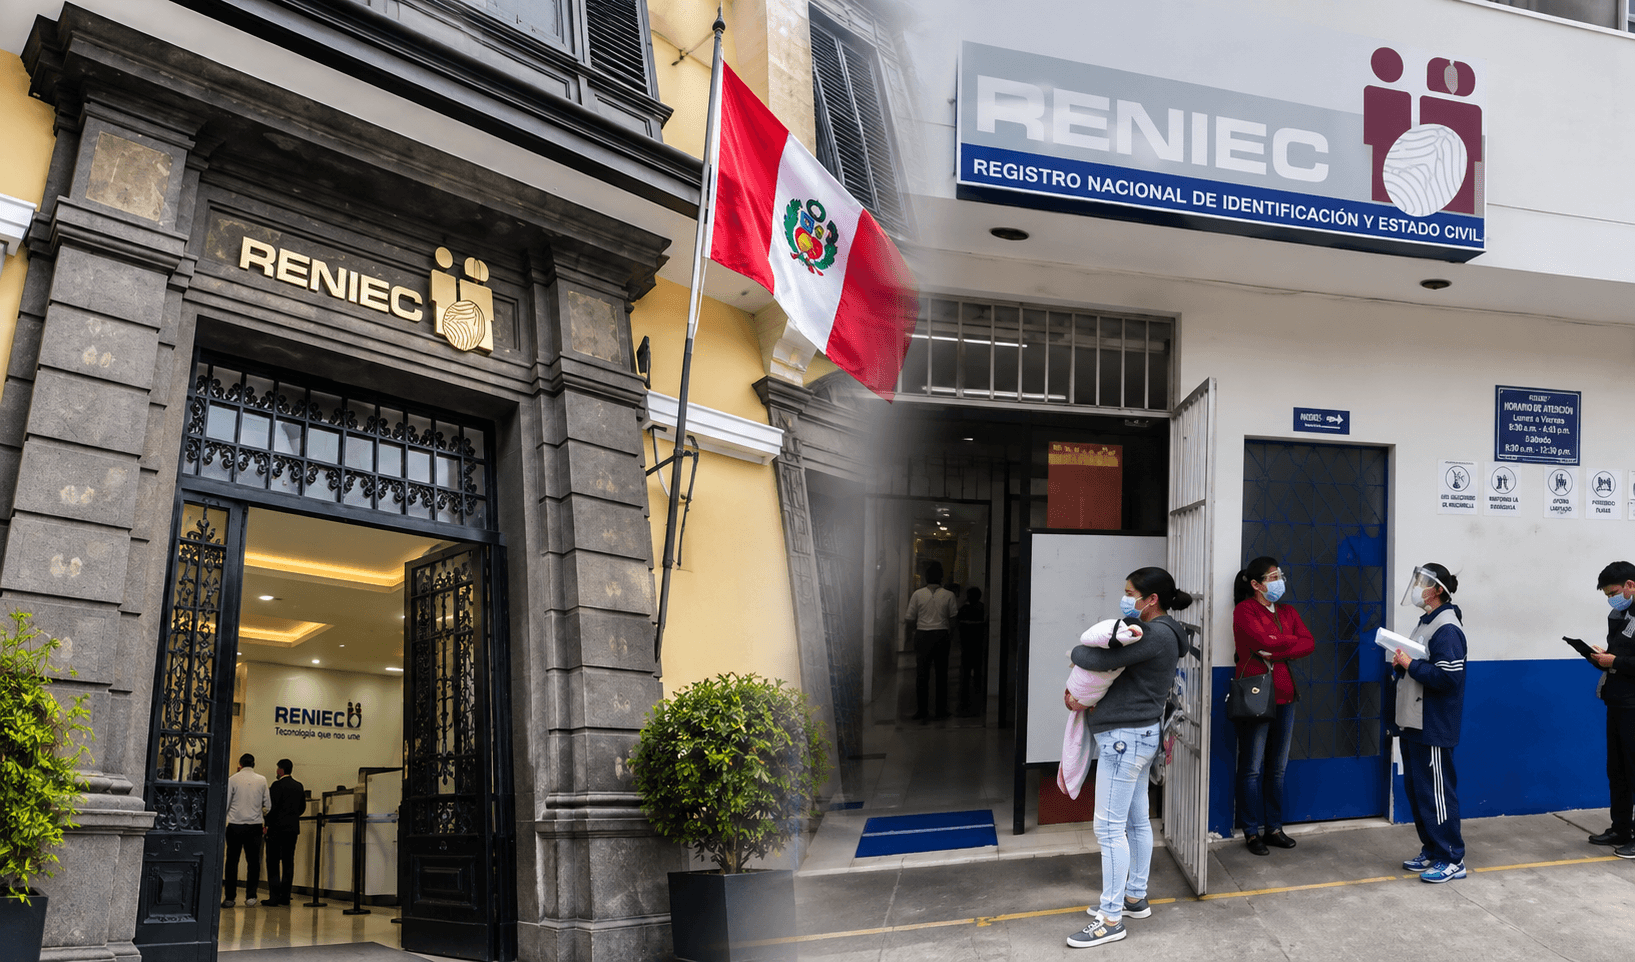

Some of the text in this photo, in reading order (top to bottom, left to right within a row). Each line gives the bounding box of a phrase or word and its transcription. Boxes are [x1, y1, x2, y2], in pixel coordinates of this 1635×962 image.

[977, 74, 1329, 183] RENIEC
[973, 158, 1483, 242] REGISTRO NACIONAL DE IDENTIFICACIÓN Y ESTADO CIVIL
[239, 235, 423, 323] RENIEC
[275, 706, 345, 727] RENIEC
